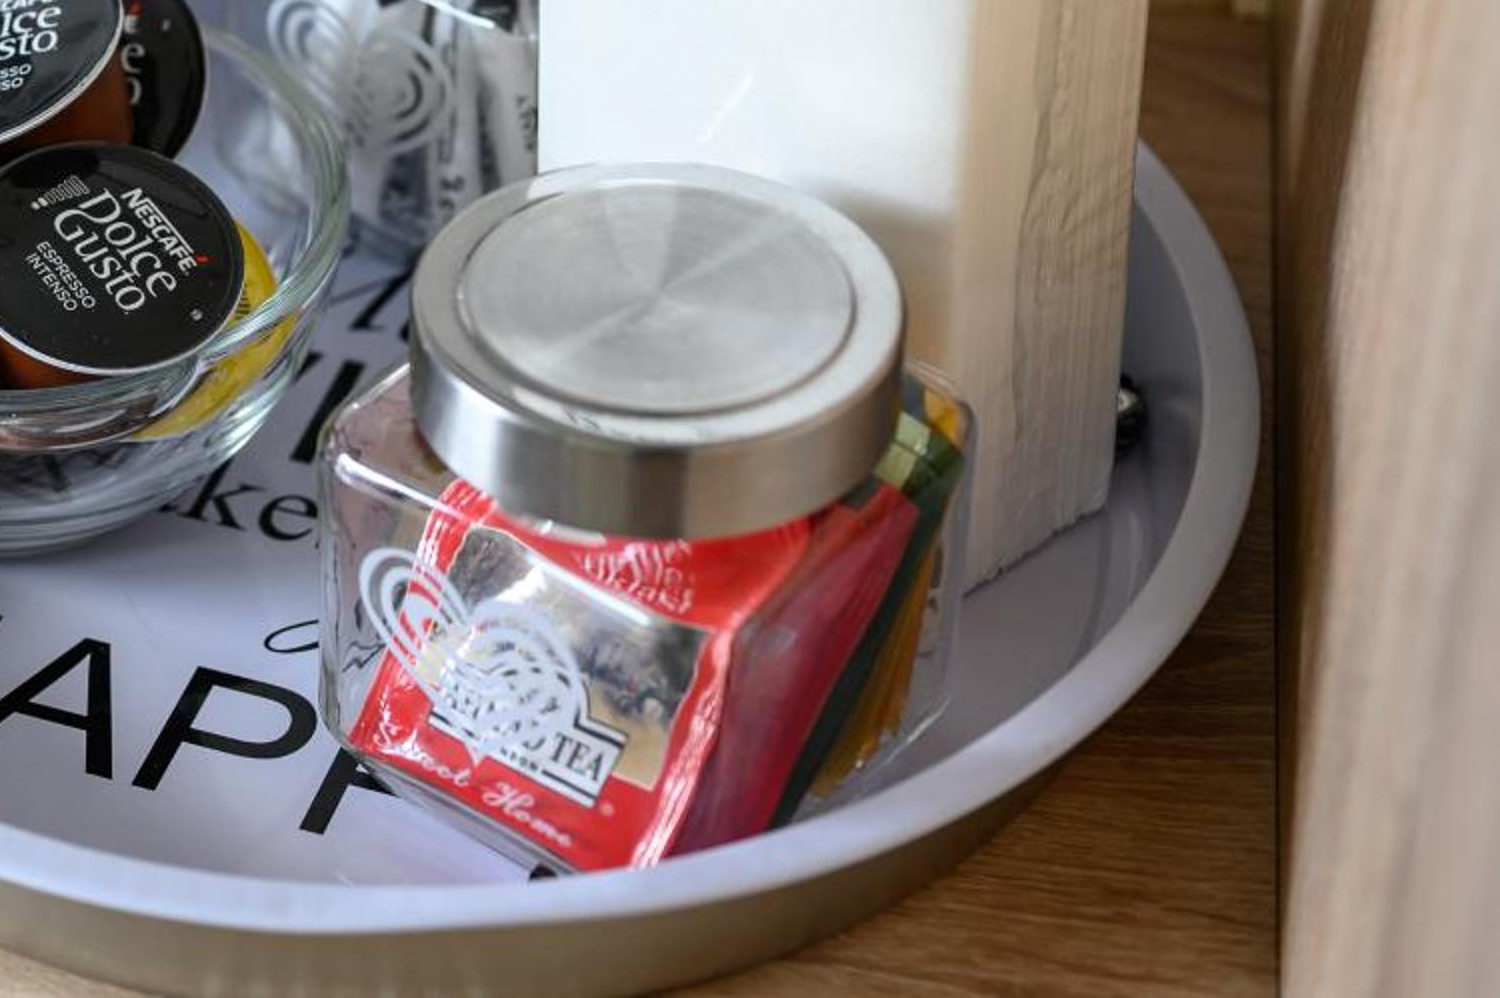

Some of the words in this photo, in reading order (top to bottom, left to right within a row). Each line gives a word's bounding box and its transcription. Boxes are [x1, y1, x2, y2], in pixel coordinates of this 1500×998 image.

[25, 252, 78, 311] INTENSO
[35, 241, 96, 309] ESPRESSO
[551, 732, 604, 782] TEA
